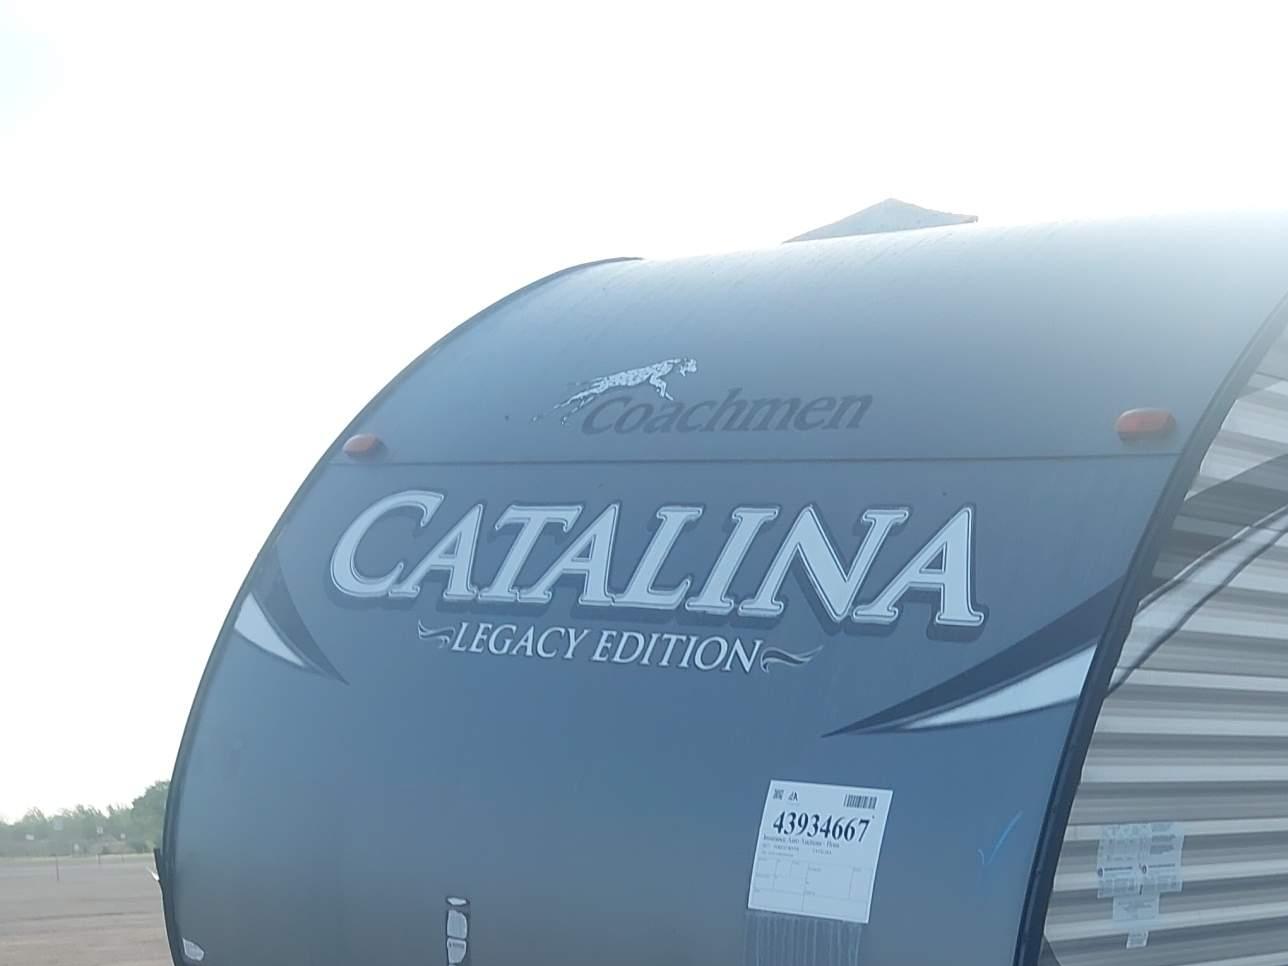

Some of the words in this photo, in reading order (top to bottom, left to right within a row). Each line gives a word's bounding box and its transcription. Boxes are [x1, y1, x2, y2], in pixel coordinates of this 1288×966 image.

[581, 387, 873, 436] Coachmen
[329, 490, 985, 630] CATALINA
[451, 622, 590, 660] LEGACY
[592, 630, 761, 673] EDITION
[773, 811, 870, 842] 43934667
